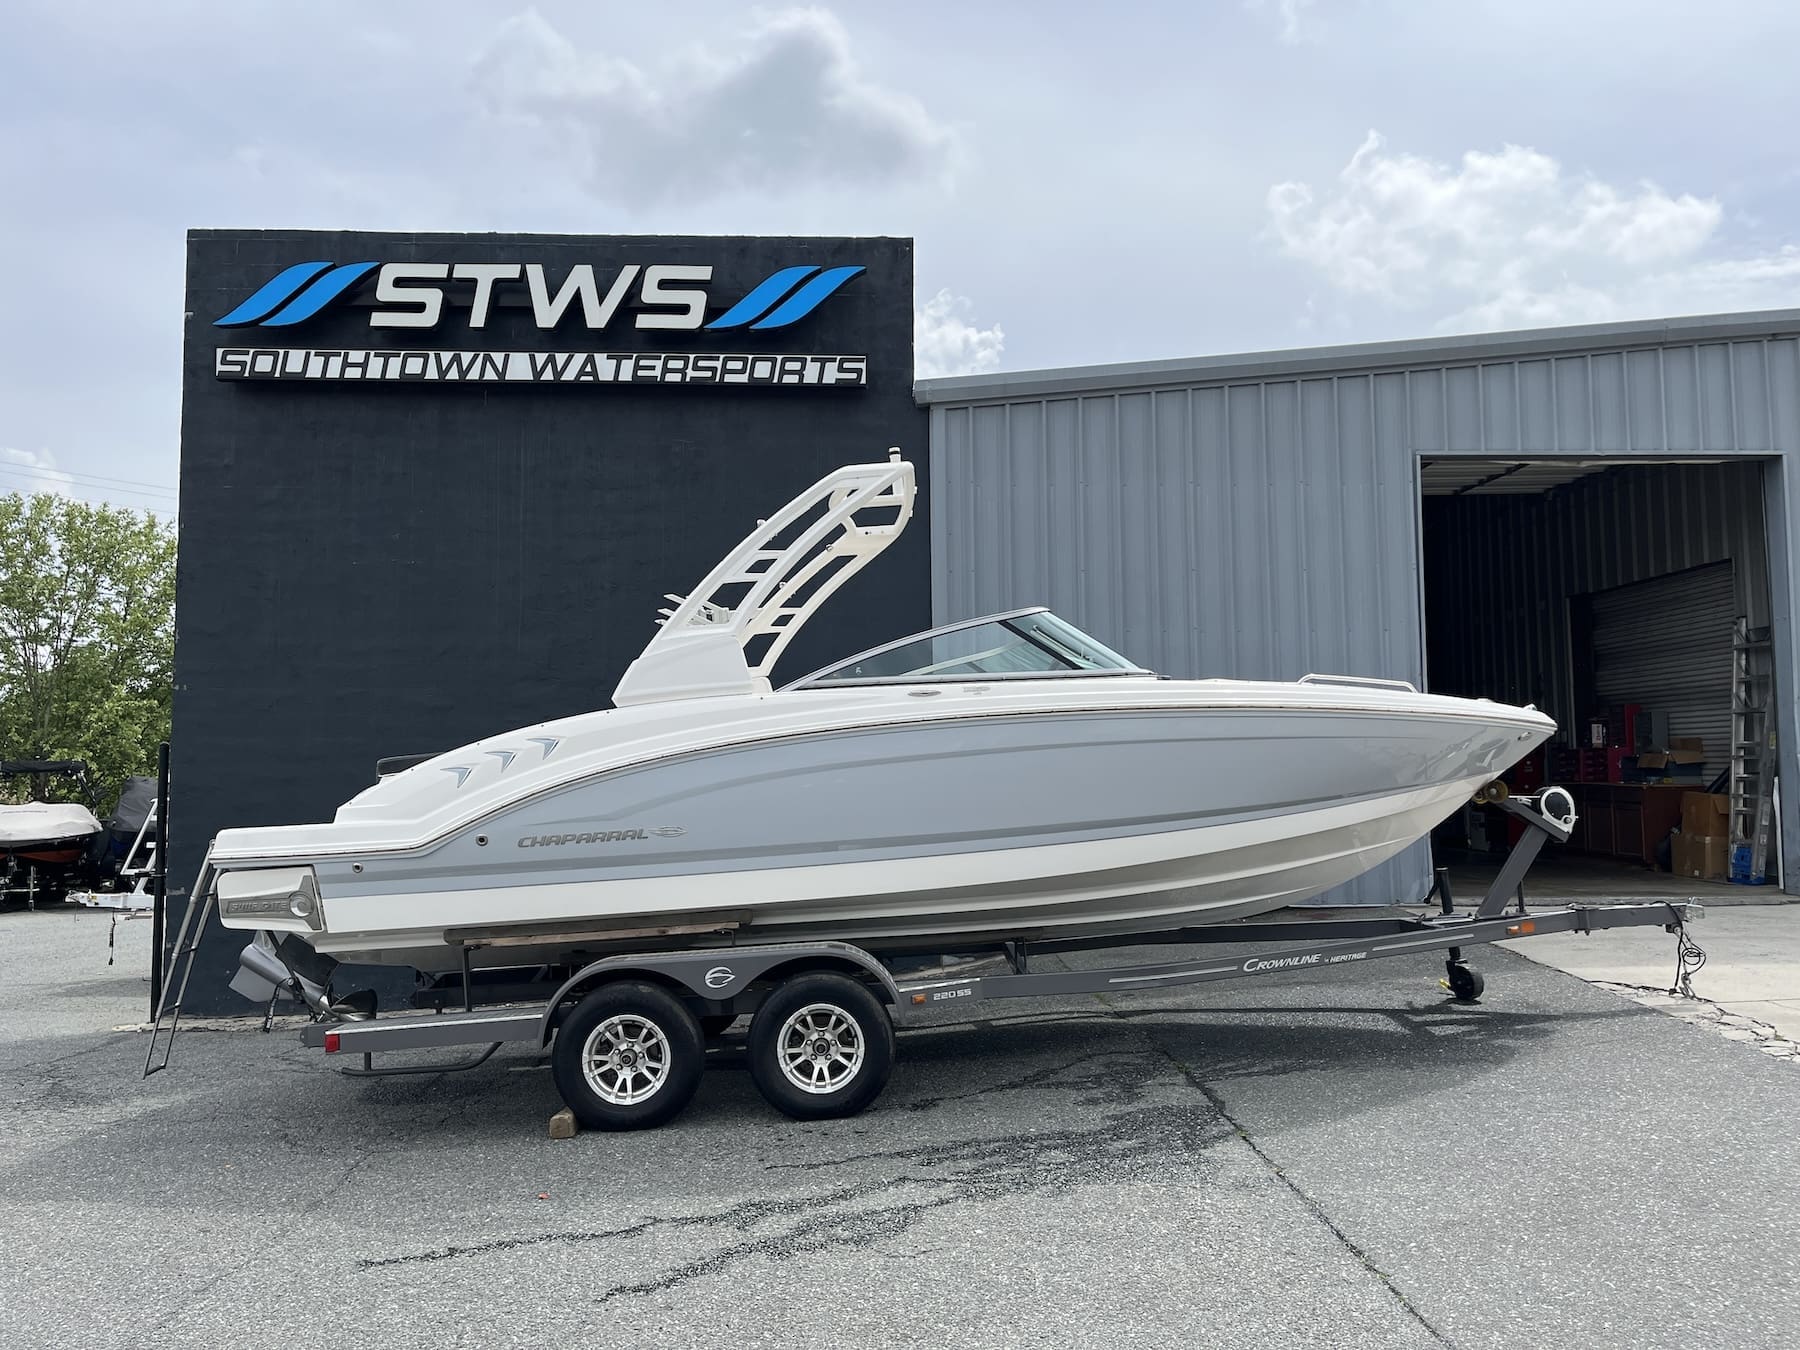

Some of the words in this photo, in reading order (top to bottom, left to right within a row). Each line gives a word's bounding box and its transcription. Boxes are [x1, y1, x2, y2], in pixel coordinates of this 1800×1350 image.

[370, 263, 713, 329] STWS
[218, 350, 511, 380] SOUTHTOWN
[529, 353, 866, 384] WATERSPORTS
[517, 828, 649, 848] CHAPARRAL
[1329, 952, 1367, 963] HERITAGE
